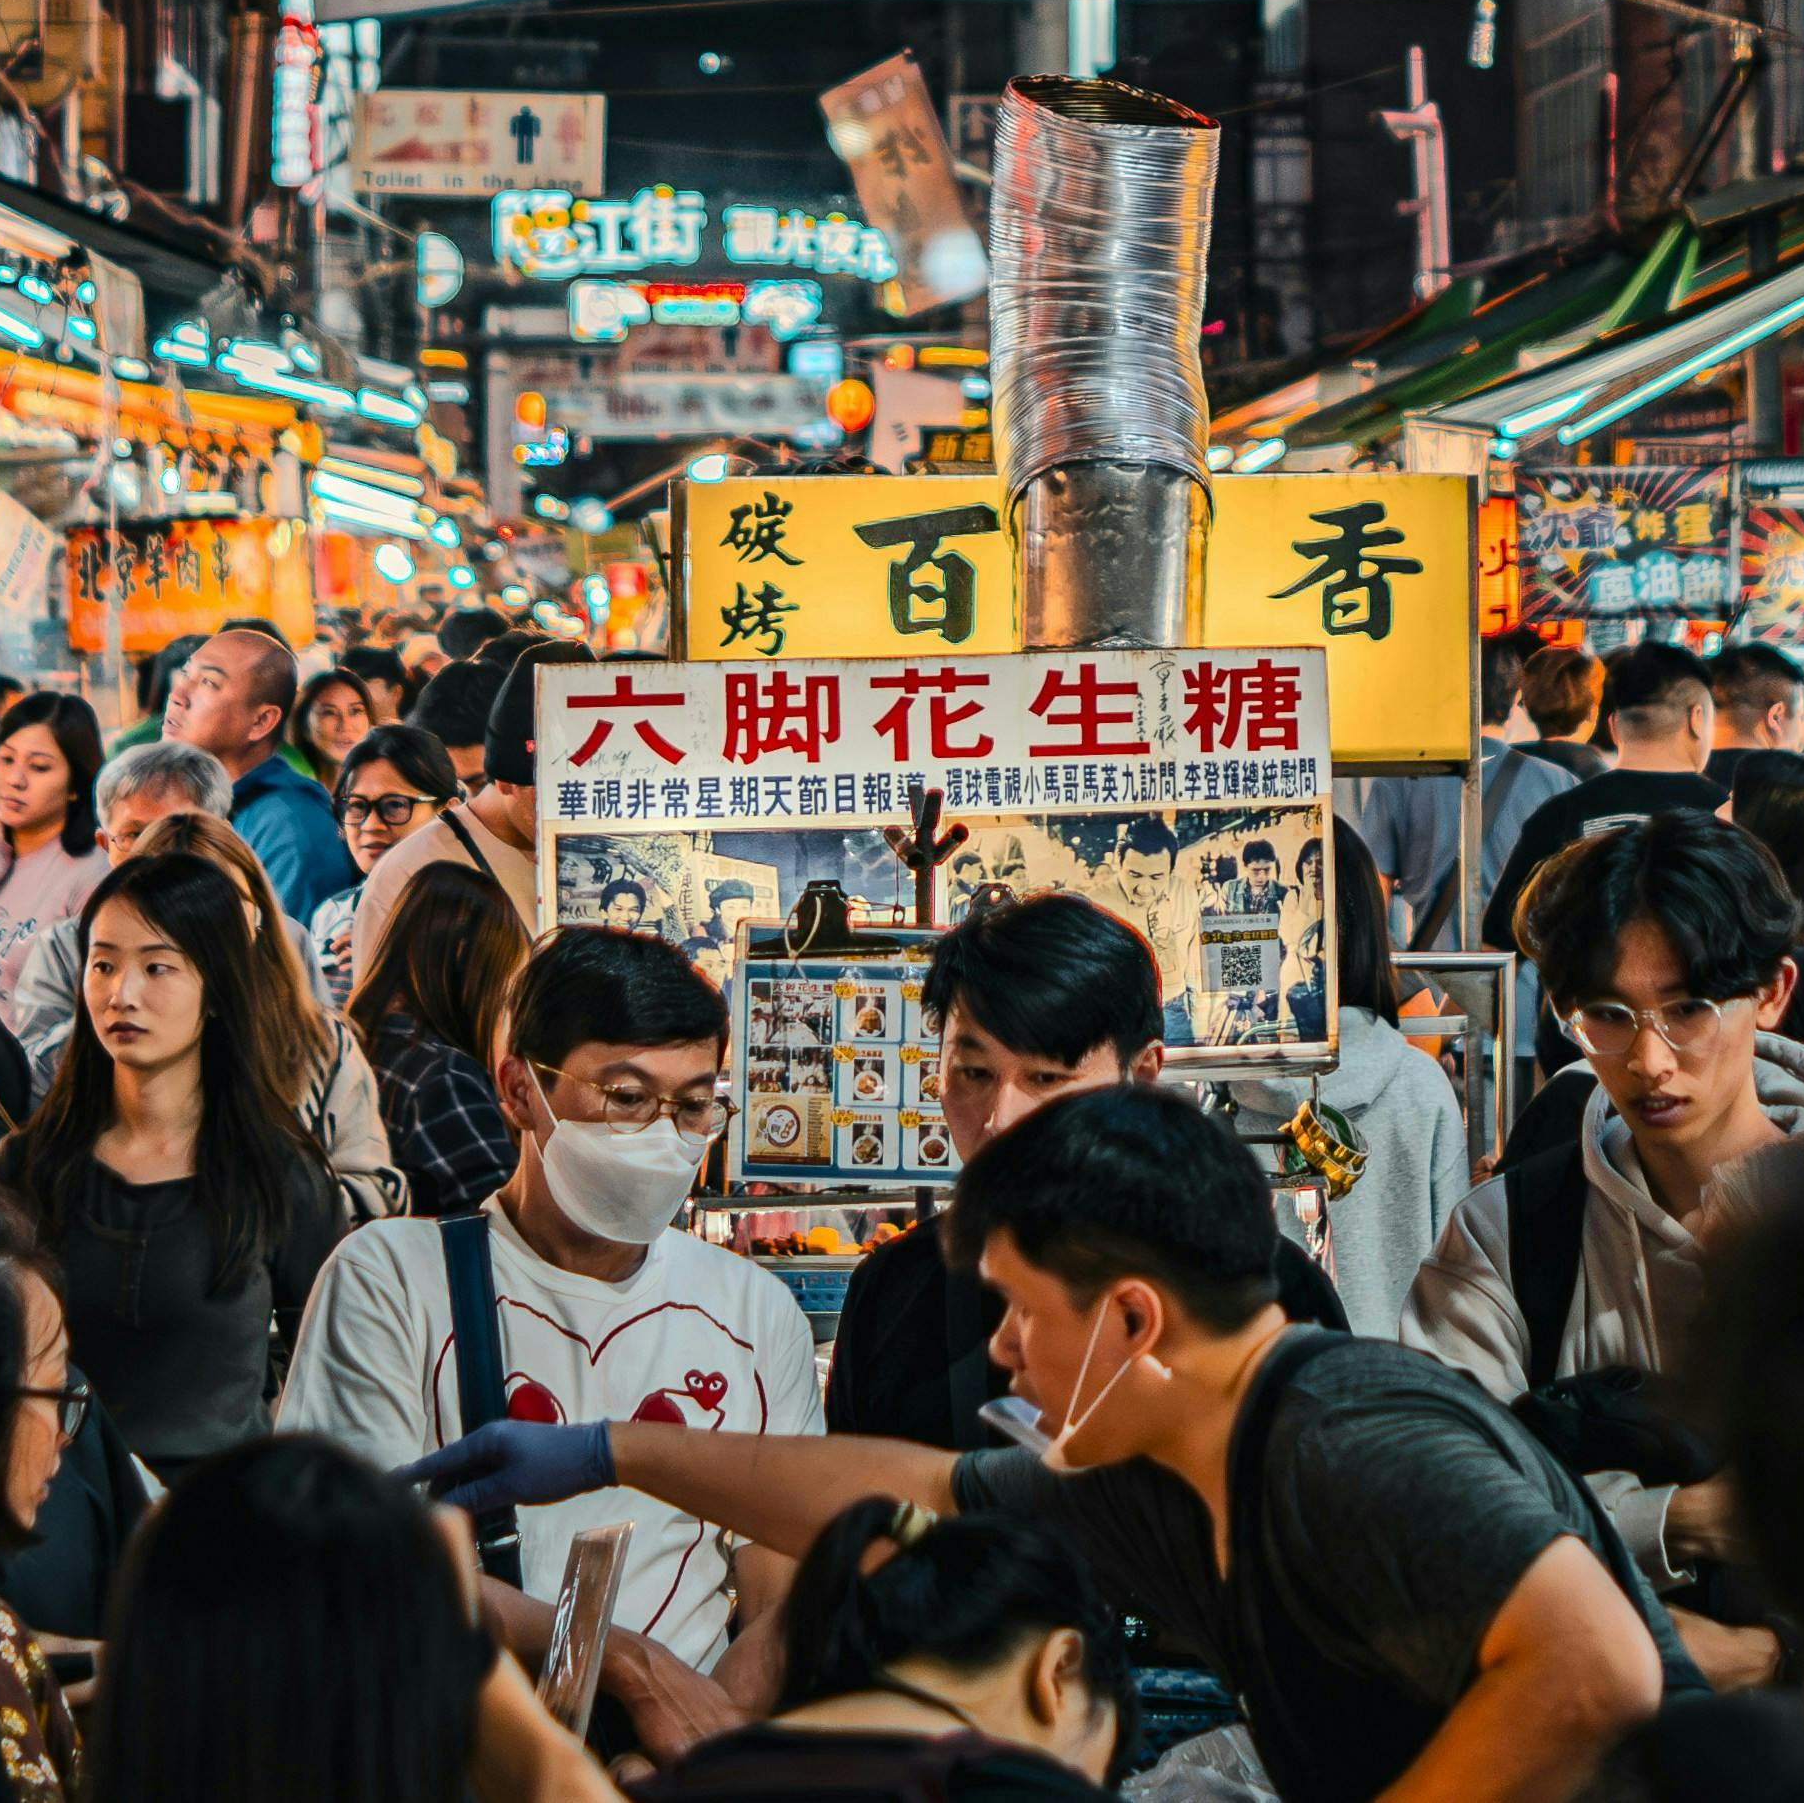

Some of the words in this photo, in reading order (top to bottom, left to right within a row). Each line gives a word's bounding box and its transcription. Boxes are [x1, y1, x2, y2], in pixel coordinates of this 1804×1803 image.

[362, 169, 423, 188] Toilet
[443, 173, 464, 187] in
[77, 531, 233, 603] 北京羊肉串
[722, 490, 804, 656] 碳烤
[854, 501, 1001, 646] 百
[1271, 500, 1425, 642] 香
